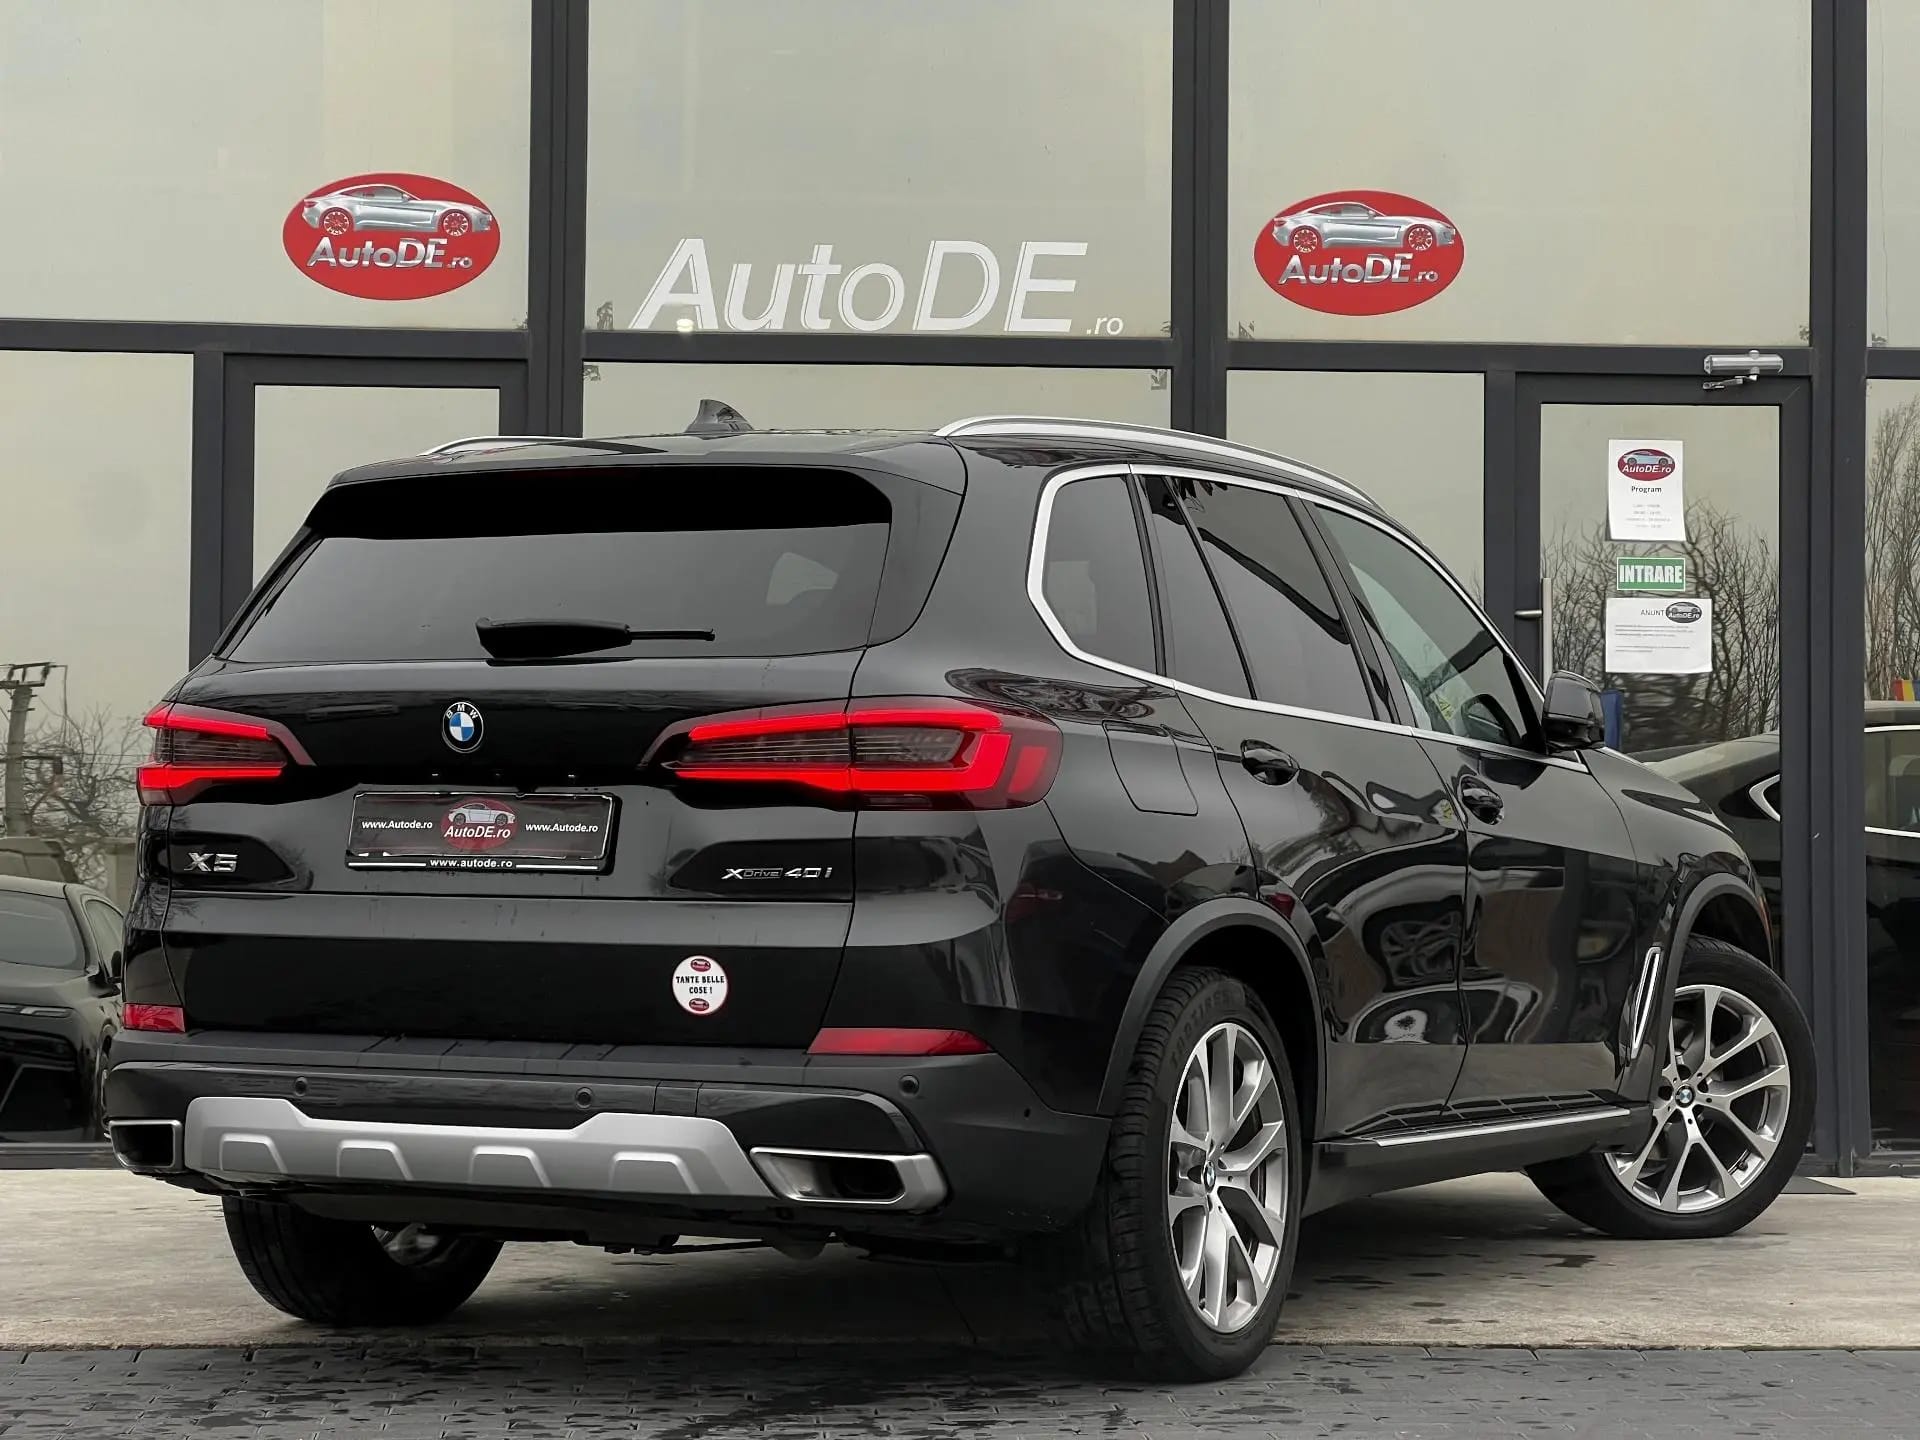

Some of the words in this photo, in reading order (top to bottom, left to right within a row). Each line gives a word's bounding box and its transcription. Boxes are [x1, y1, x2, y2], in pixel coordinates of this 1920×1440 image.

[1621, 464, 1672, 473] AutoDE.ro
[1631, 486, 1662, 494] Program
[1620, 565, 1683, 584] INTRARE
[1640, 609, 1665, 617] ANUNT
[445, 703, 479, 719] BMW
[361, 819, 433, 830] www.Autode.ro
[525, 822, 599, 834] www.Autode.ro
[443, 825, 512, 839] AutoDE.ro
[183, 852, 239, 873] X5
[429, 857, 513, 869] www.autode.ro
[676, 976, 700, 984] TANTE
[702, 976, 725, 984] BELLE
[689, 986, 708, 994] COSE
